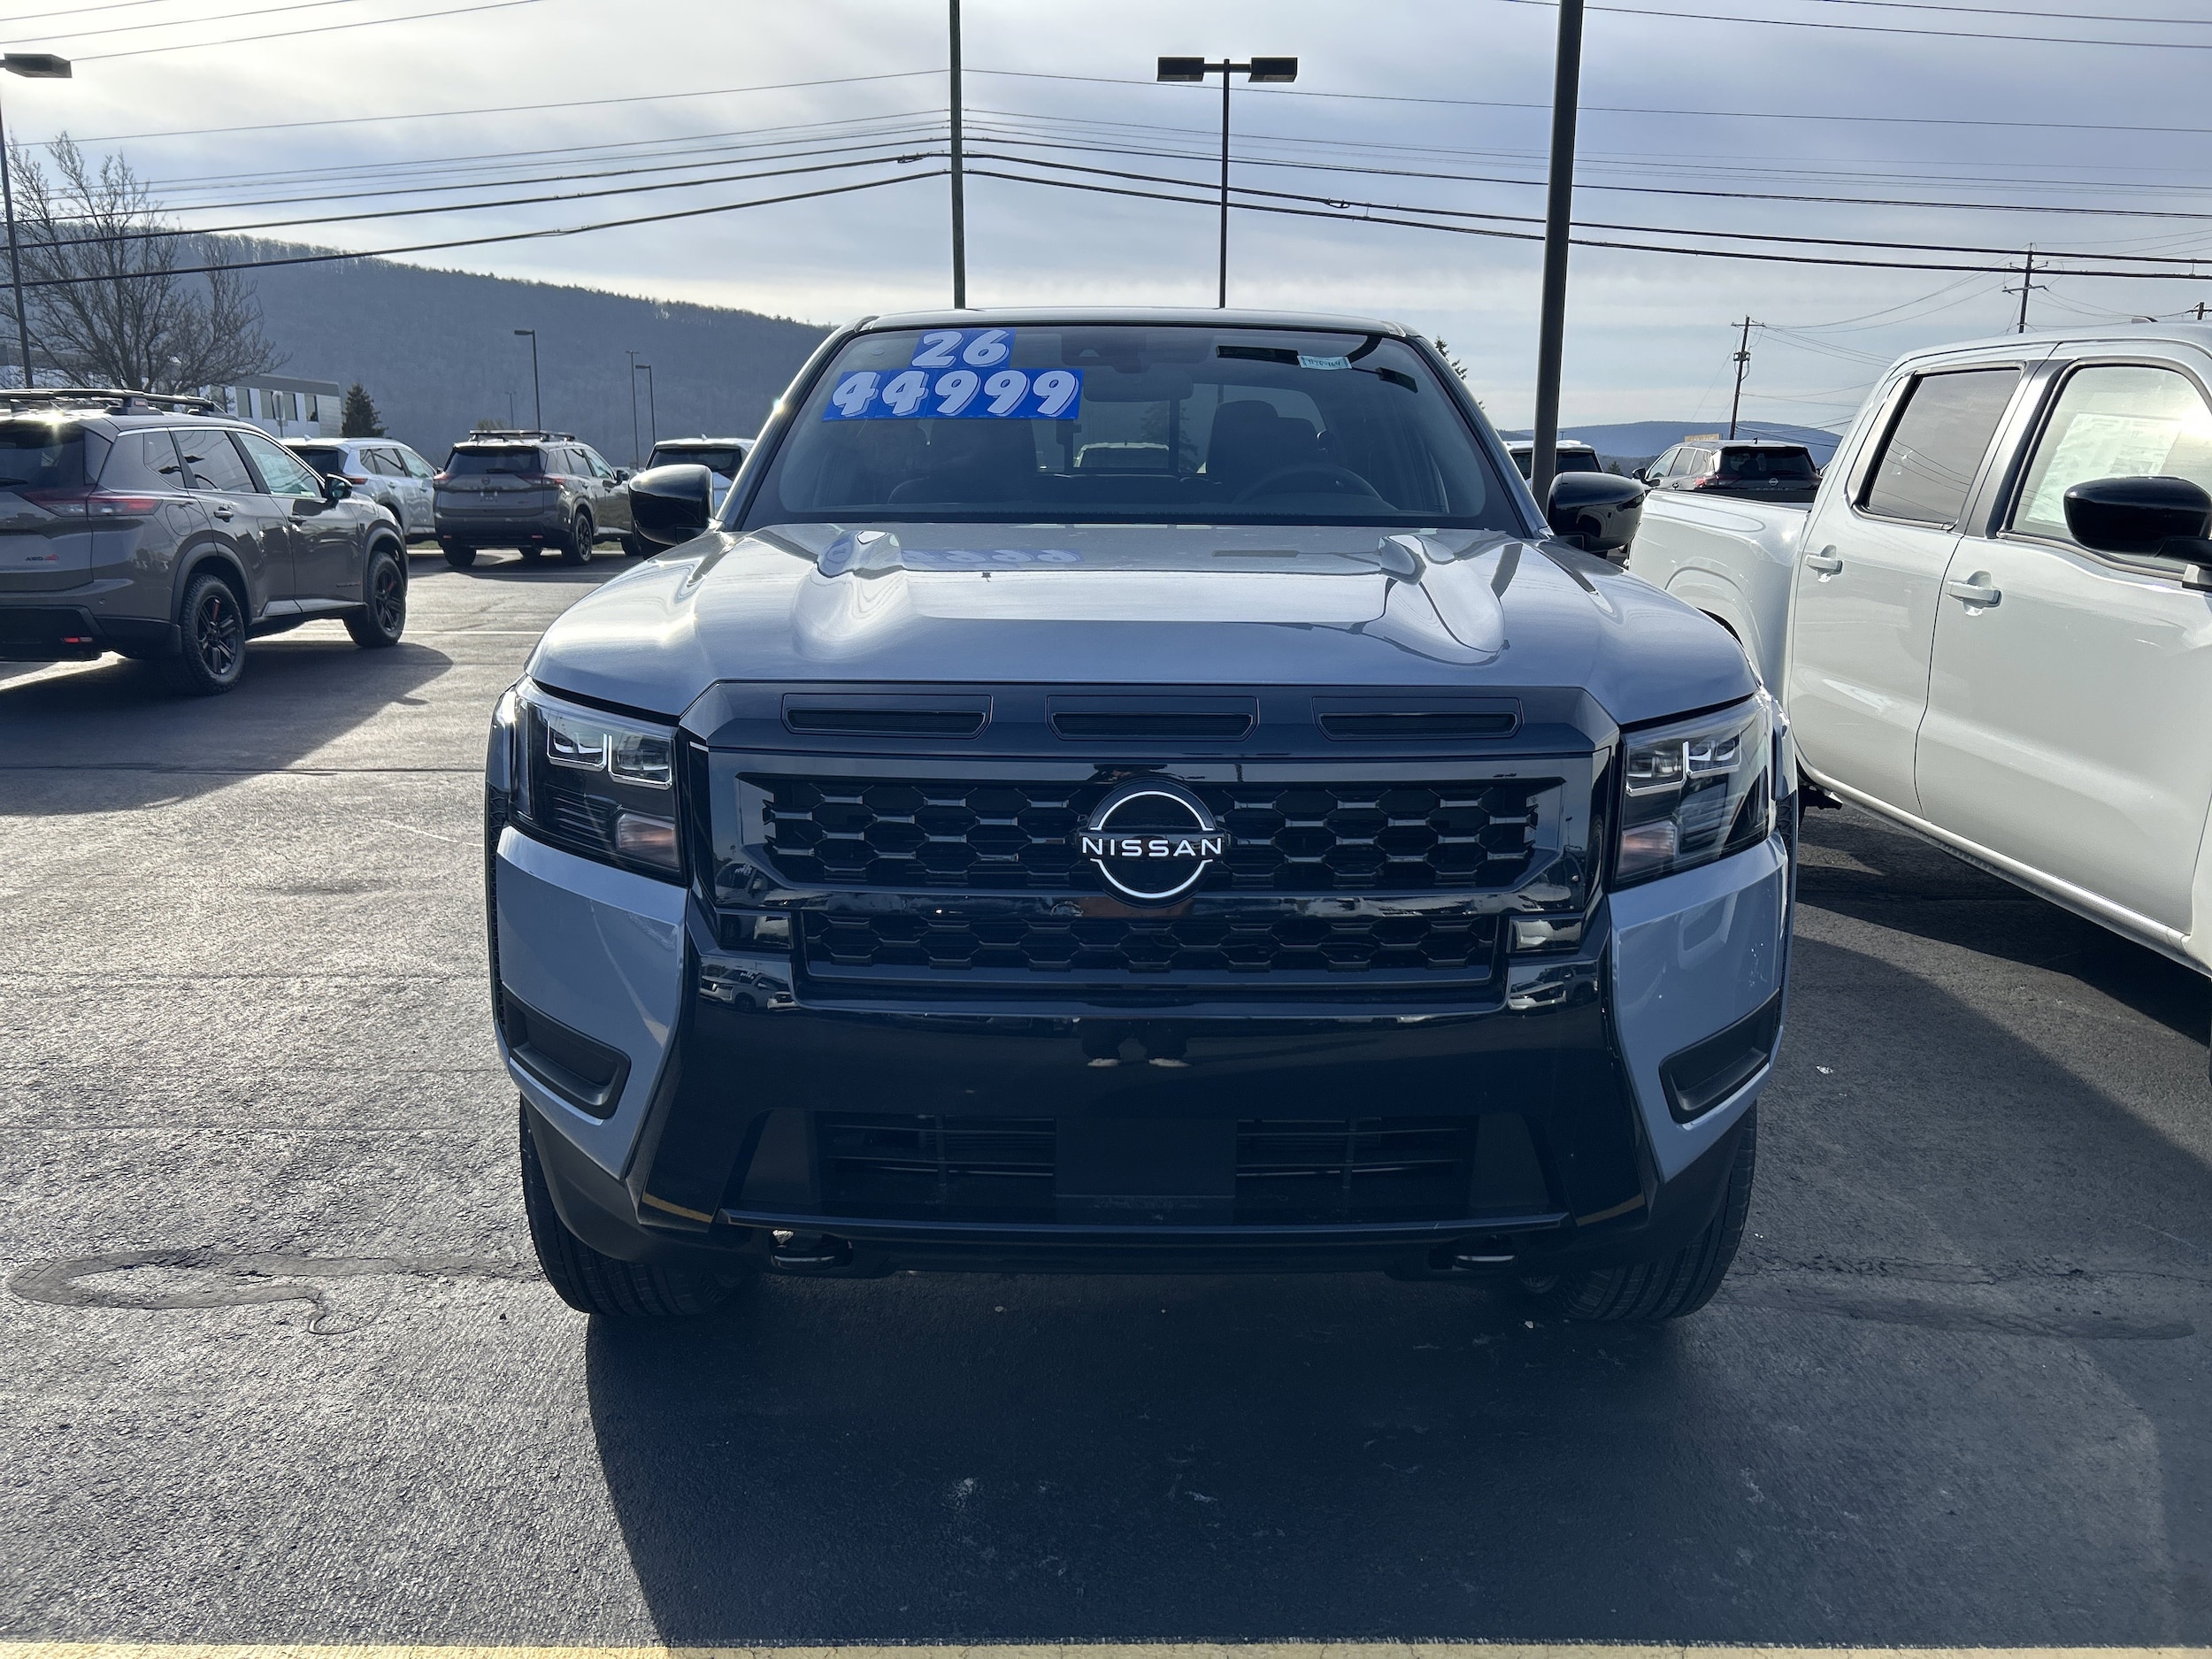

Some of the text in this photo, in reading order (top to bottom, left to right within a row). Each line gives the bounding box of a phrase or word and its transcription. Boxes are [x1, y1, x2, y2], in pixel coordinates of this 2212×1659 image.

[911, 330, 1010, 367] 26
[833, 370, 1079, 417] 44999
[1081, 836, 1223, 857] NISSAN
